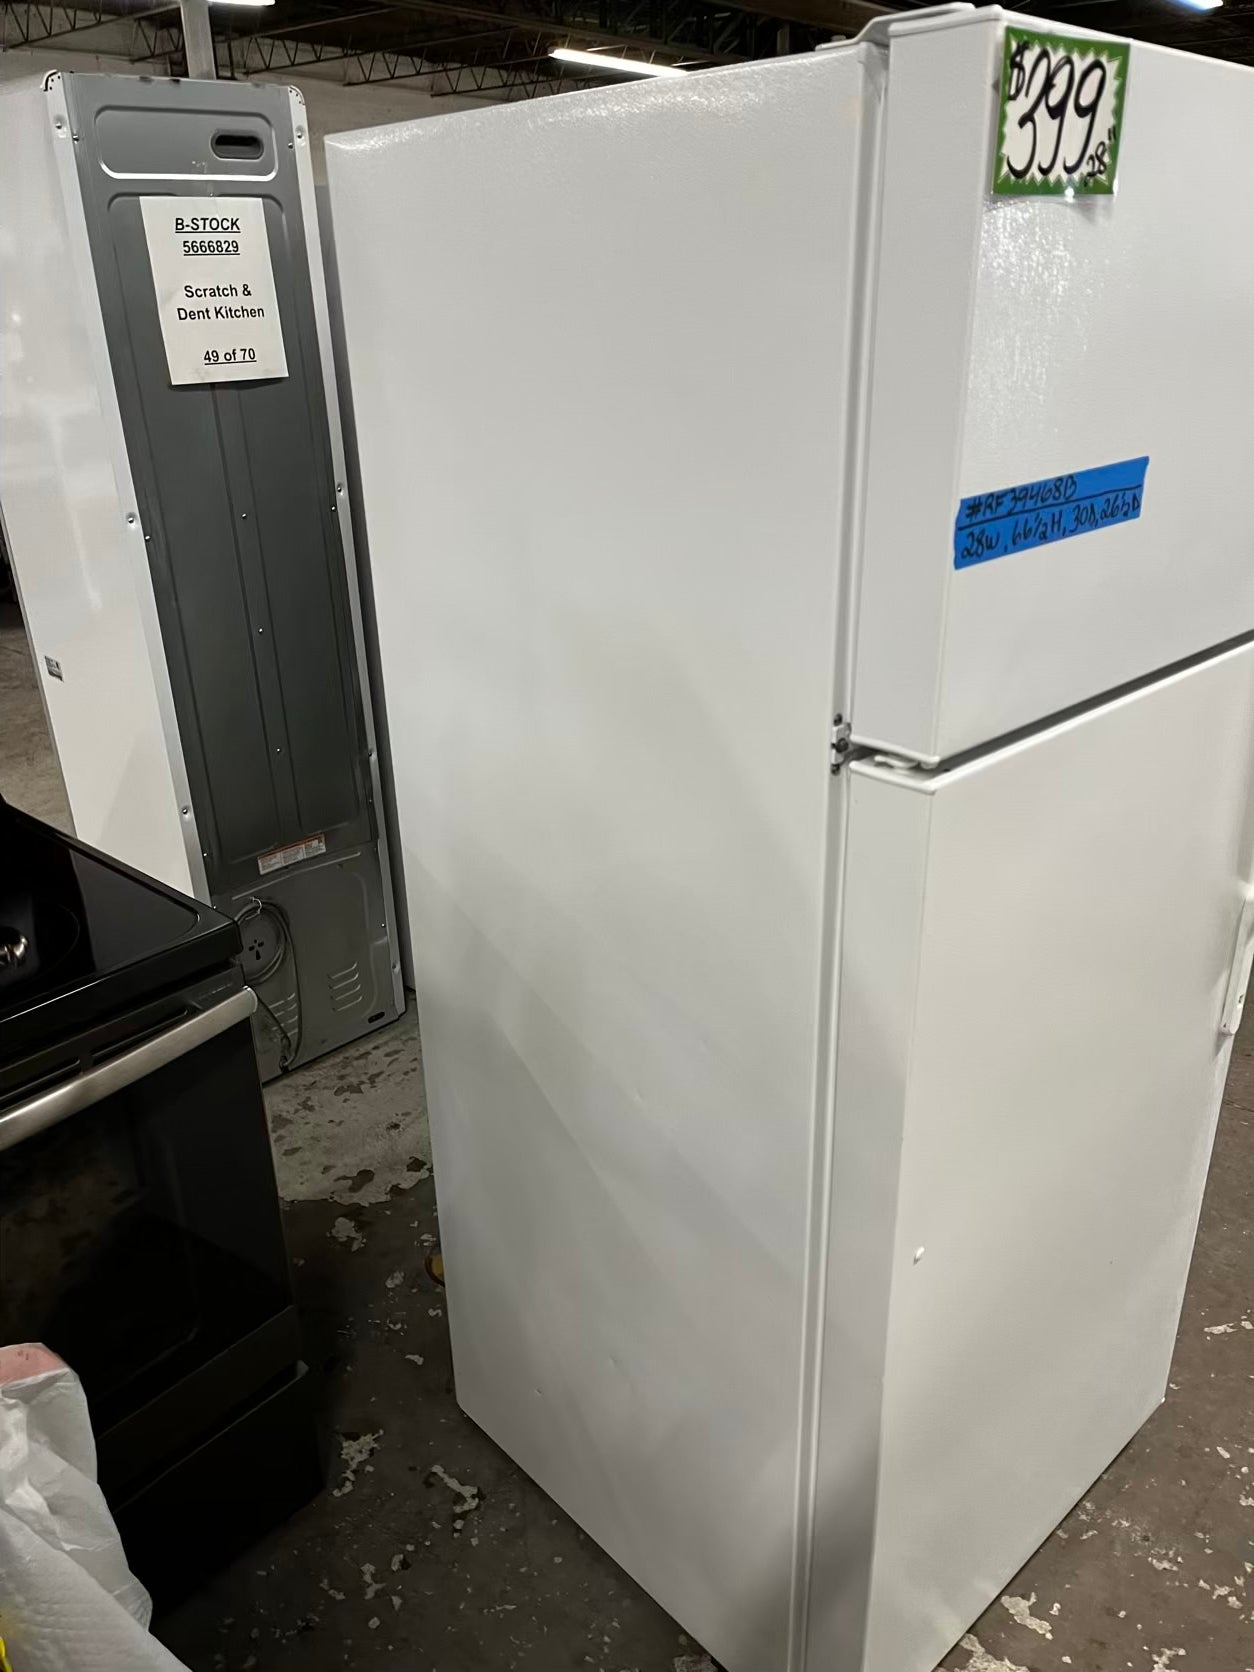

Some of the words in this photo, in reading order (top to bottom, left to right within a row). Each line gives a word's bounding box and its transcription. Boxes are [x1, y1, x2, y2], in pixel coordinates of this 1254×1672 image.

[175, 217, 241, 232] B-STOCK
[182, 240, 240, 254] 5666829
[184, 284, 239, 299] Scratch
[242, 283, 252, 297] &
[177, 307, 211, 321] Dent
[214, 305, 265, 320] Kitchen
[203, 349, 219, 363] 49
[223, 349, 237, 362] of
[240, 348, 256, 361] 70
